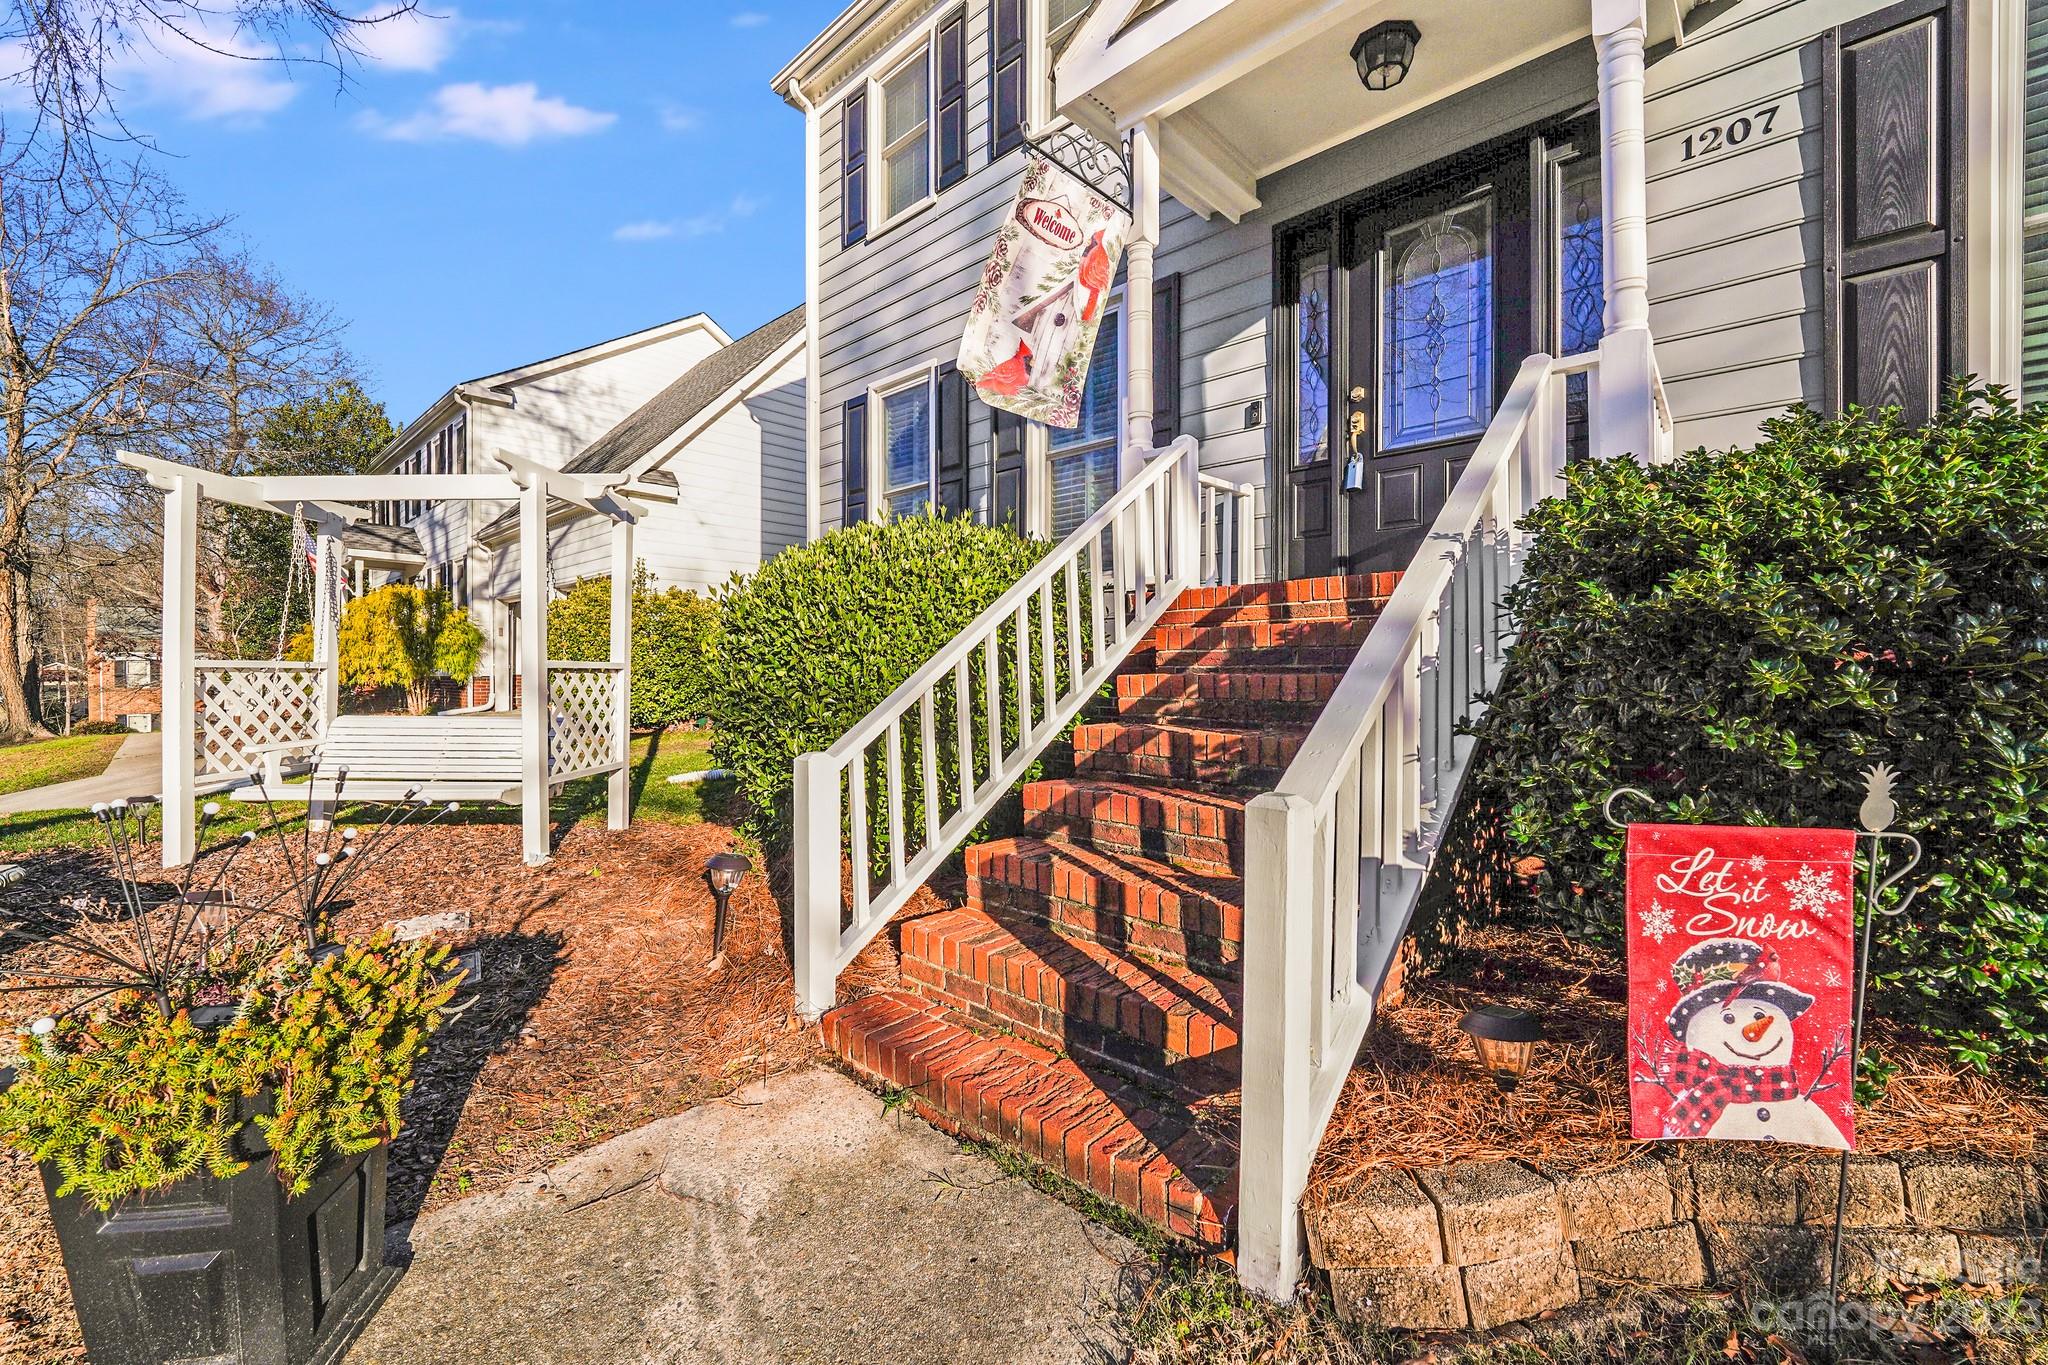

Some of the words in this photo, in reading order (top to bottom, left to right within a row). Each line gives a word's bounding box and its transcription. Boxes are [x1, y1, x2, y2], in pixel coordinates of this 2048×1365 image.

[1681, 105, 1780, 162] 1207
[1033, 207, 1076, 245] Welcome
[1656, 847, 1737, 897] Let
[1743, 877, 1771, 904] it
[1686, 892, 1817, 940] Snow
